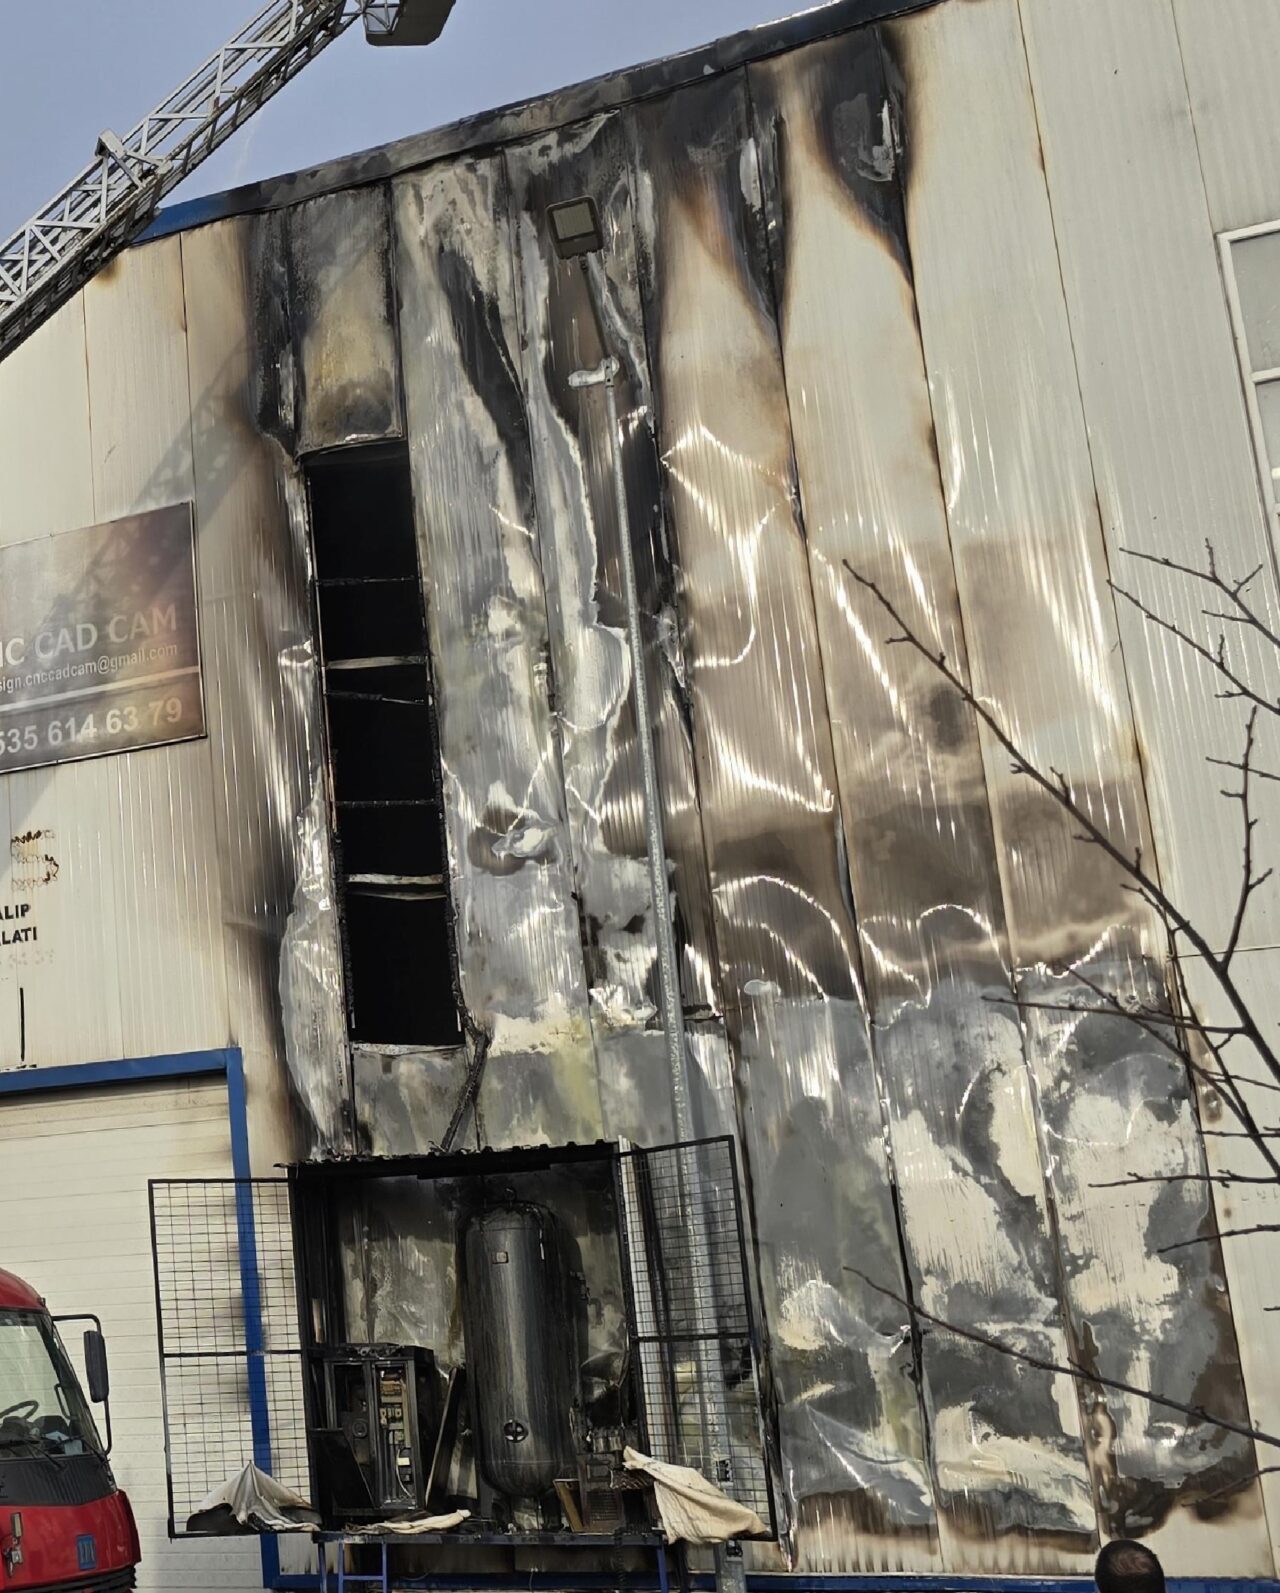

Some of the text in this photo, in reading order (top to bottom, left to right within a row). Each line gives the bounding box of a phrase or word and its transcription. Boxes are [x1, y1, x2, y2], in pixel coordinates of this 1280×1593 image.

[34, 623, 98, 659] CAD
[107, 604, 178, 644] CAM
[47, 713, 98, 746] 614
[105, 705, 139, 734] 63
[148, 697, 183, 726] 79
